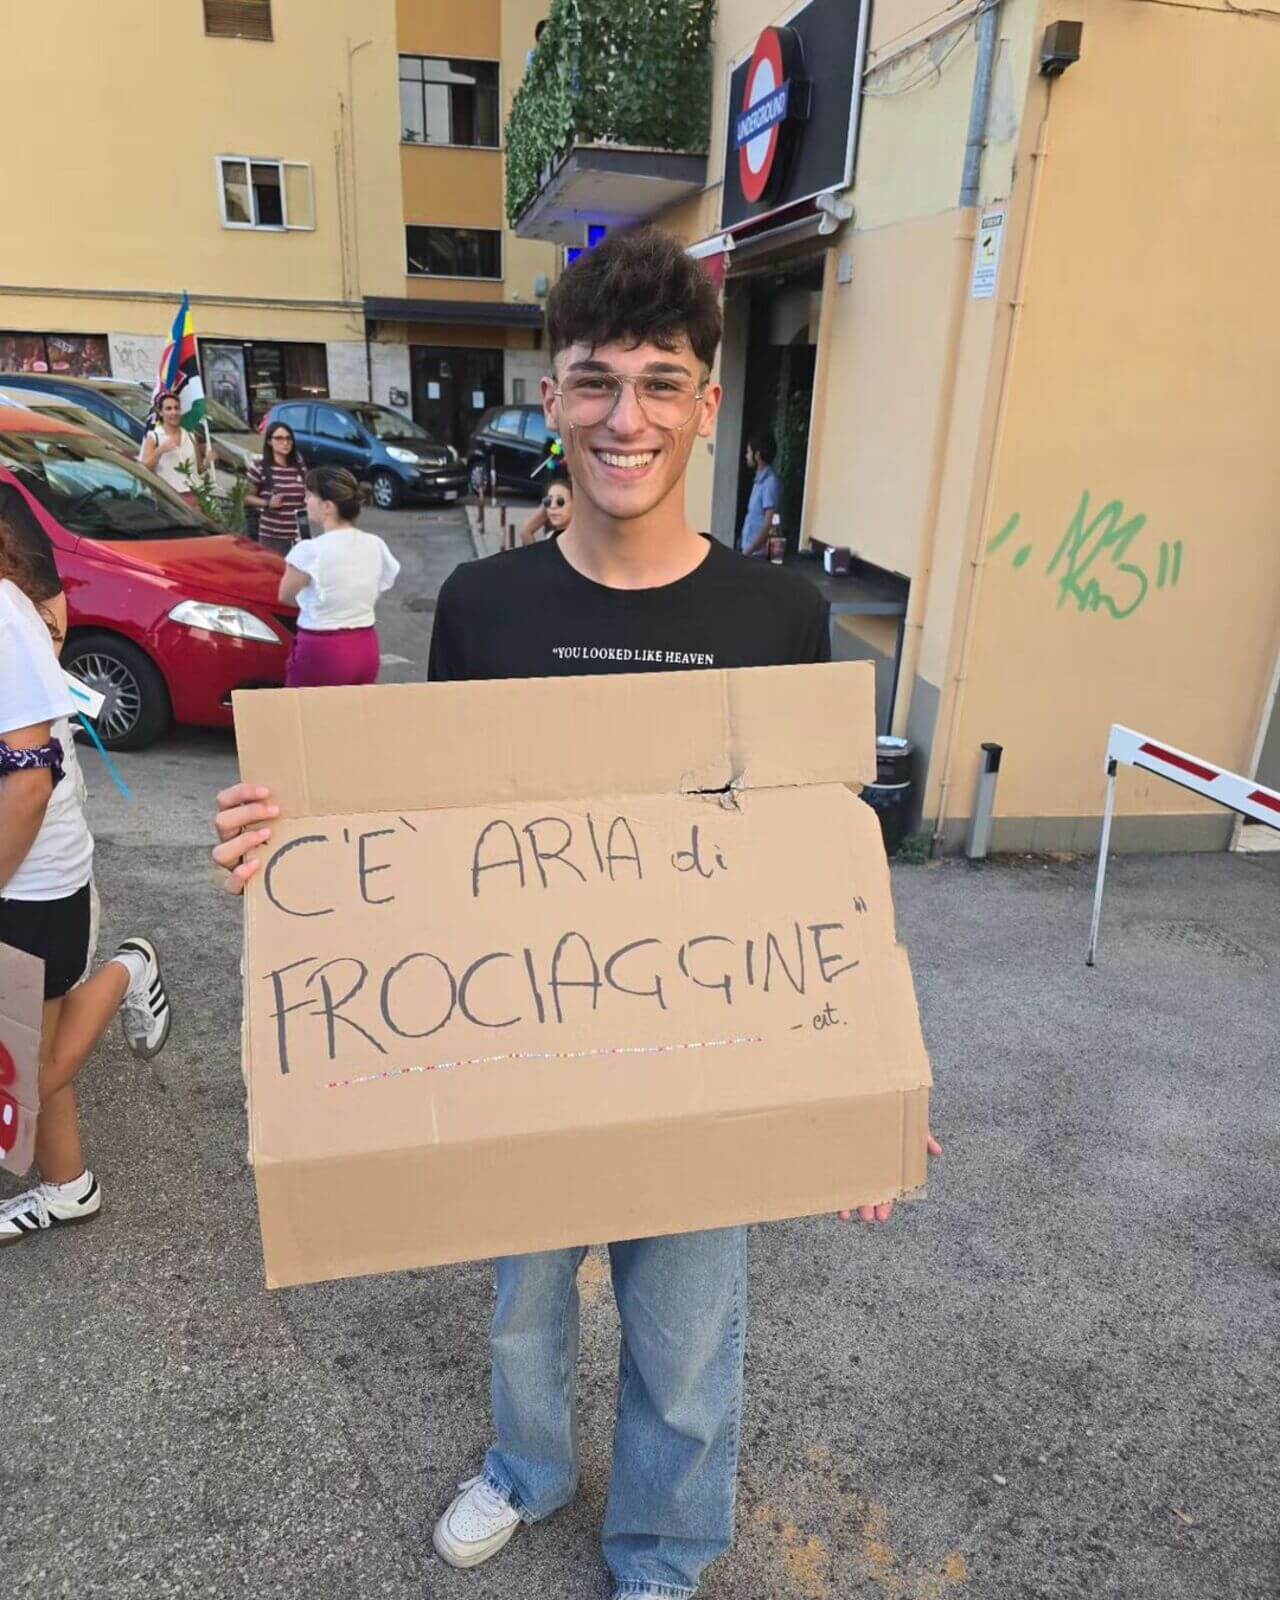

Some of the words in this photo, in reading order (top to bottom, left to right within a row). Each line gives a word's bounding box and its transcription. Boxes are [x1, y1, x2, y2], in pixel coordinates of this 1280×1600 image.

[737, 91, 785, 141] UNDERGROUND
[583, 647, 633, 661] LOOKED
[634, 649, 663, 663] LIKE
[664, 651, 715, 665] HEAVEN
[471, 812, 642, 898] ARIA
[670, 825, 728, 879] di
